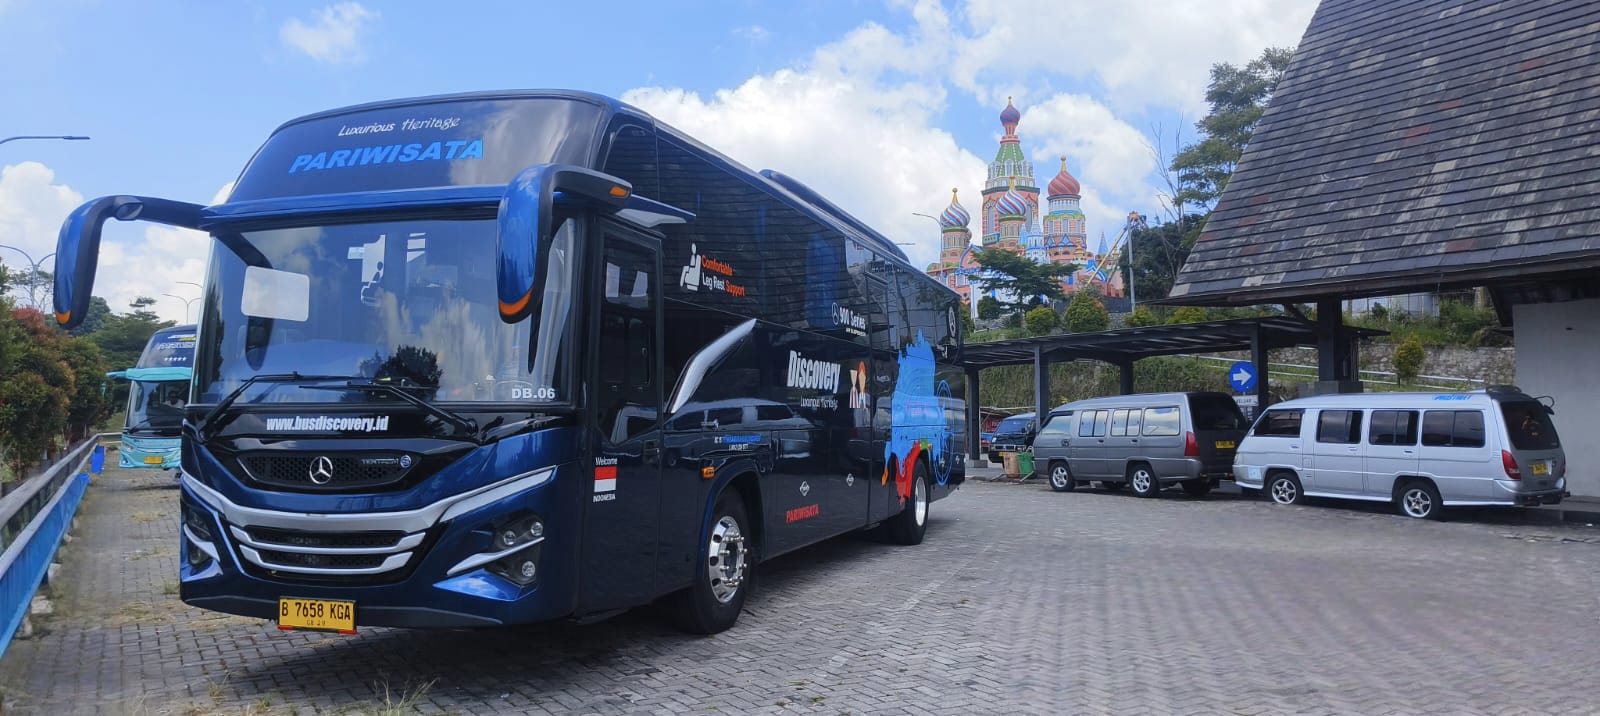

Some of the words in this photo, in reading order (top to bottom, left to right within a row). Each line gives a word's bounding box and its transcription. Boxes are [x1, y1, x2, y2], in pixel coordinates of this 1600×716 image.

[338, 122, 395, 137] Luxurious
[401, 116, 461, 131] Heritage
[288, 138, 484, 174] PARIWISATA
[702, 272, 713, 291] Leg
[850, 309, 866, 330] Series
[787, 350, 841, 394] Discovery
[511, 387, 556, 399] DB.06
[266, 415, 389, 432] www.busdiscovery.id
[595, 456, 618, 466] Welcome
[592, 493, 616, 503] INDONESIA
[281, 601, 289, 617] B
[295, 601, 324, 618] 7658
[329, 603, 351, 620] KGA
